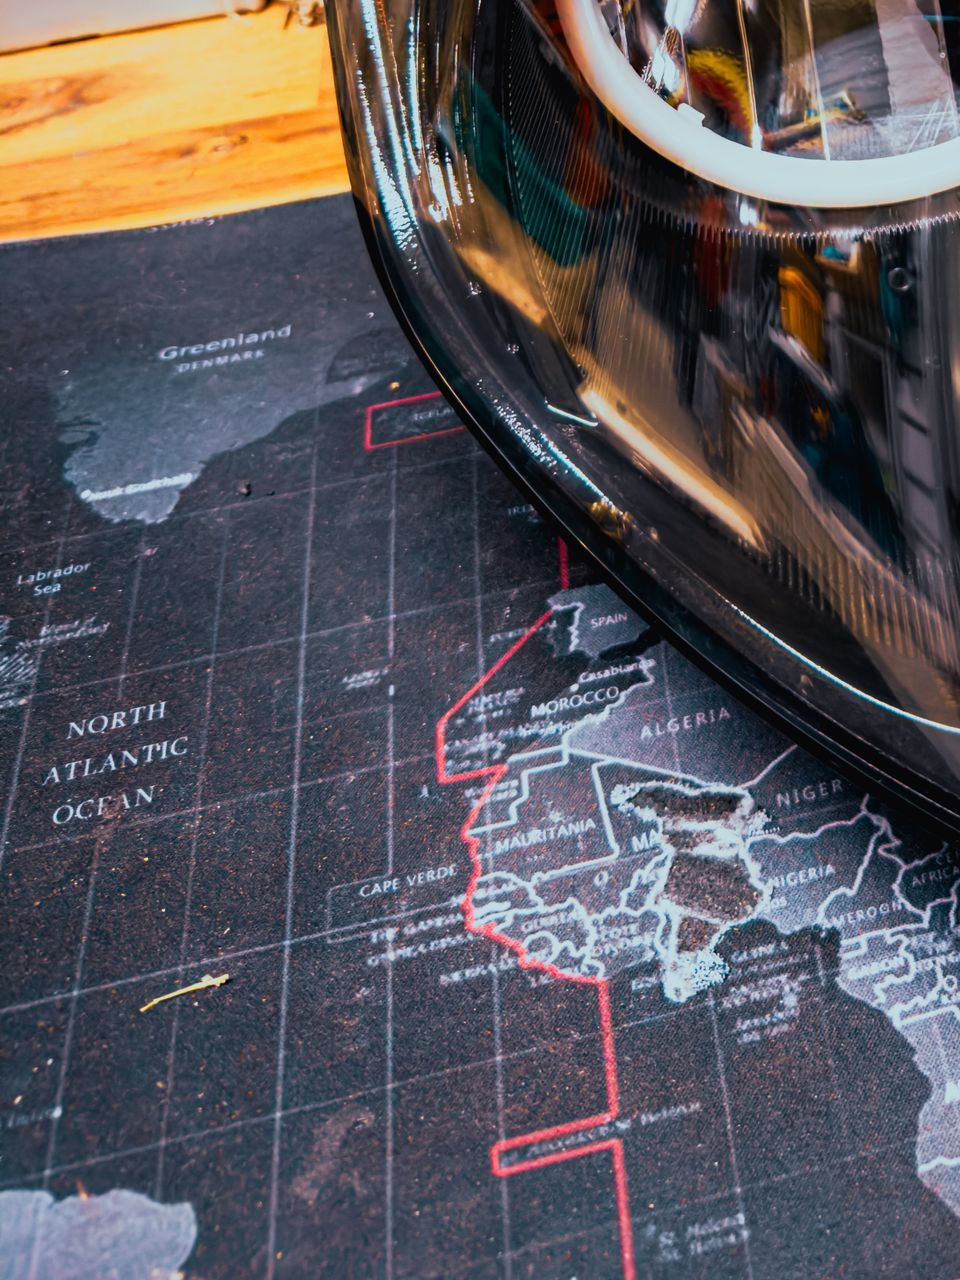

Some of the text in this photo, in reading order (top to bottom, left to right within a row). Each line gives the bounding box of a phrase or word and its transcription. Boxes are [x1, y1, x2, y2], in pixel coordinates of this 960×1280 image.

[158, 324, 292, 360] Greenland
[176, 348, 264, 373] DENMARK
[17, 562, 91, 585] Labrador
[33, 582, 62, 596] Sea
[591, 612, 628, 629] SPAIN
[530, 686, 620, 720] MOROCCO
[66, 700, 168, 740] NORTH
[640, 707, 731, 740] ALGERIA
[41, 736, 189, 786] ATLANTIC
[776, 778, 844, 808] NIGER
[495, 818, 596, 853] MAURITANIA
[359, 864, 459, 898] CAPE VERDE
[767, 864, 836, 888] NIGERIA
